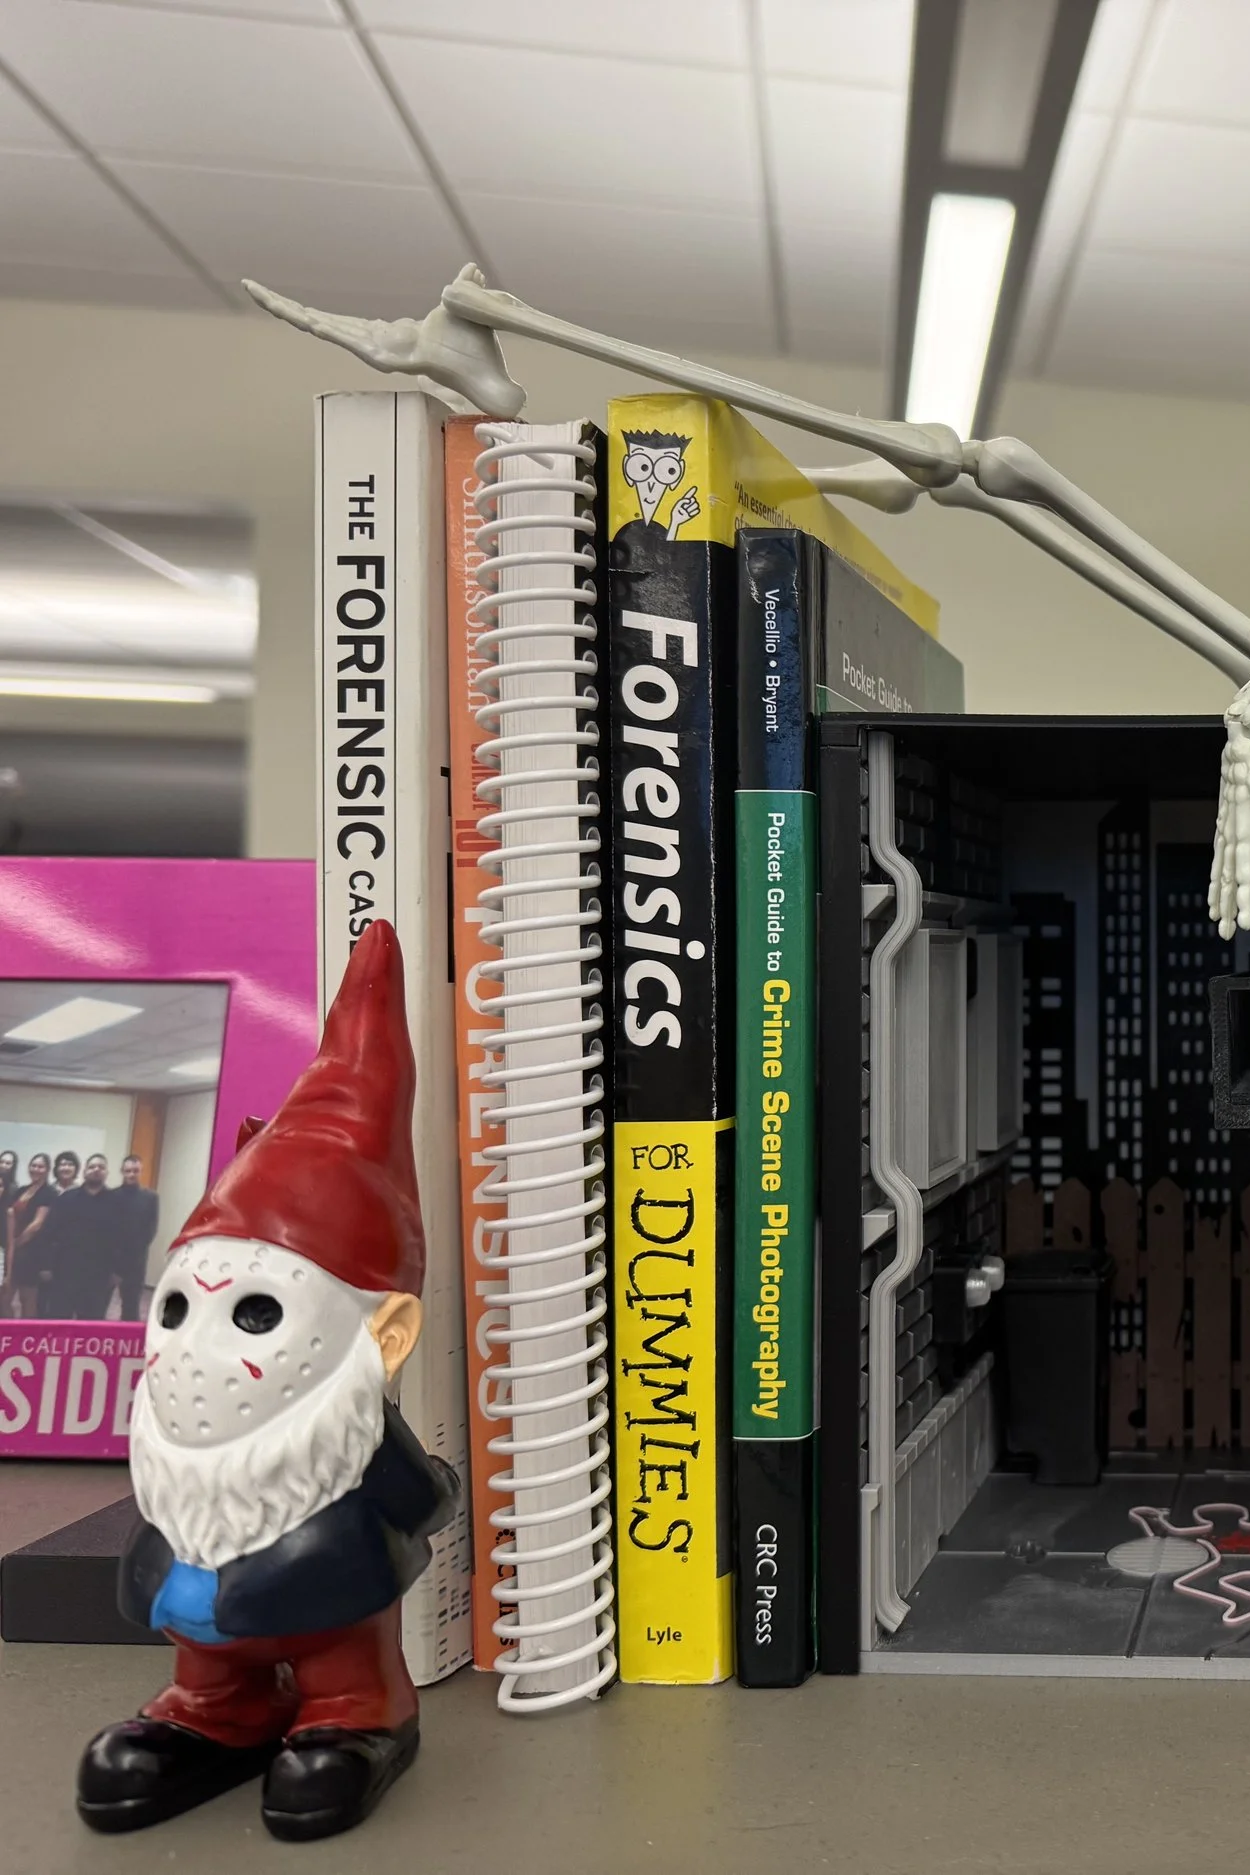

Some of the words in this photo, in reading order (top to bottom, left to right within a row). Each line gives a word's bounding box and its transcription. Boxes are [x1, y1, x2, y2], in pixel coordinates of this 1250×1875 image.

[348, 474, 375, 541] THE
[765, 588, 782, 654] Vecellio
[336, 555, 386, 861] FORENSIC
[762, 674, 781, 733] Bryant
[842, 651, 876, 700] Pocket
[620, 609, 706, 1050] Forensics
[767, 812, 785, 882] Pocket
[349, 870, 375, 957] CAS
[767, 887, 785, 945] Guide
[767, 951, 782, 972] to
[763, 979, 790, 1079] Crime
[631, 1144, 695, 1171] FOR
[762, 1091, 790, 1192] Scene
[752, 1204, 789, 1420] Photography
[622, 1187, 701, 1554] DUMMIES
[756, 1524, 779, 1577] CRC
[646, 1626, 683, 1644] Lyle
[756, 1585, 779, 1645] Press
